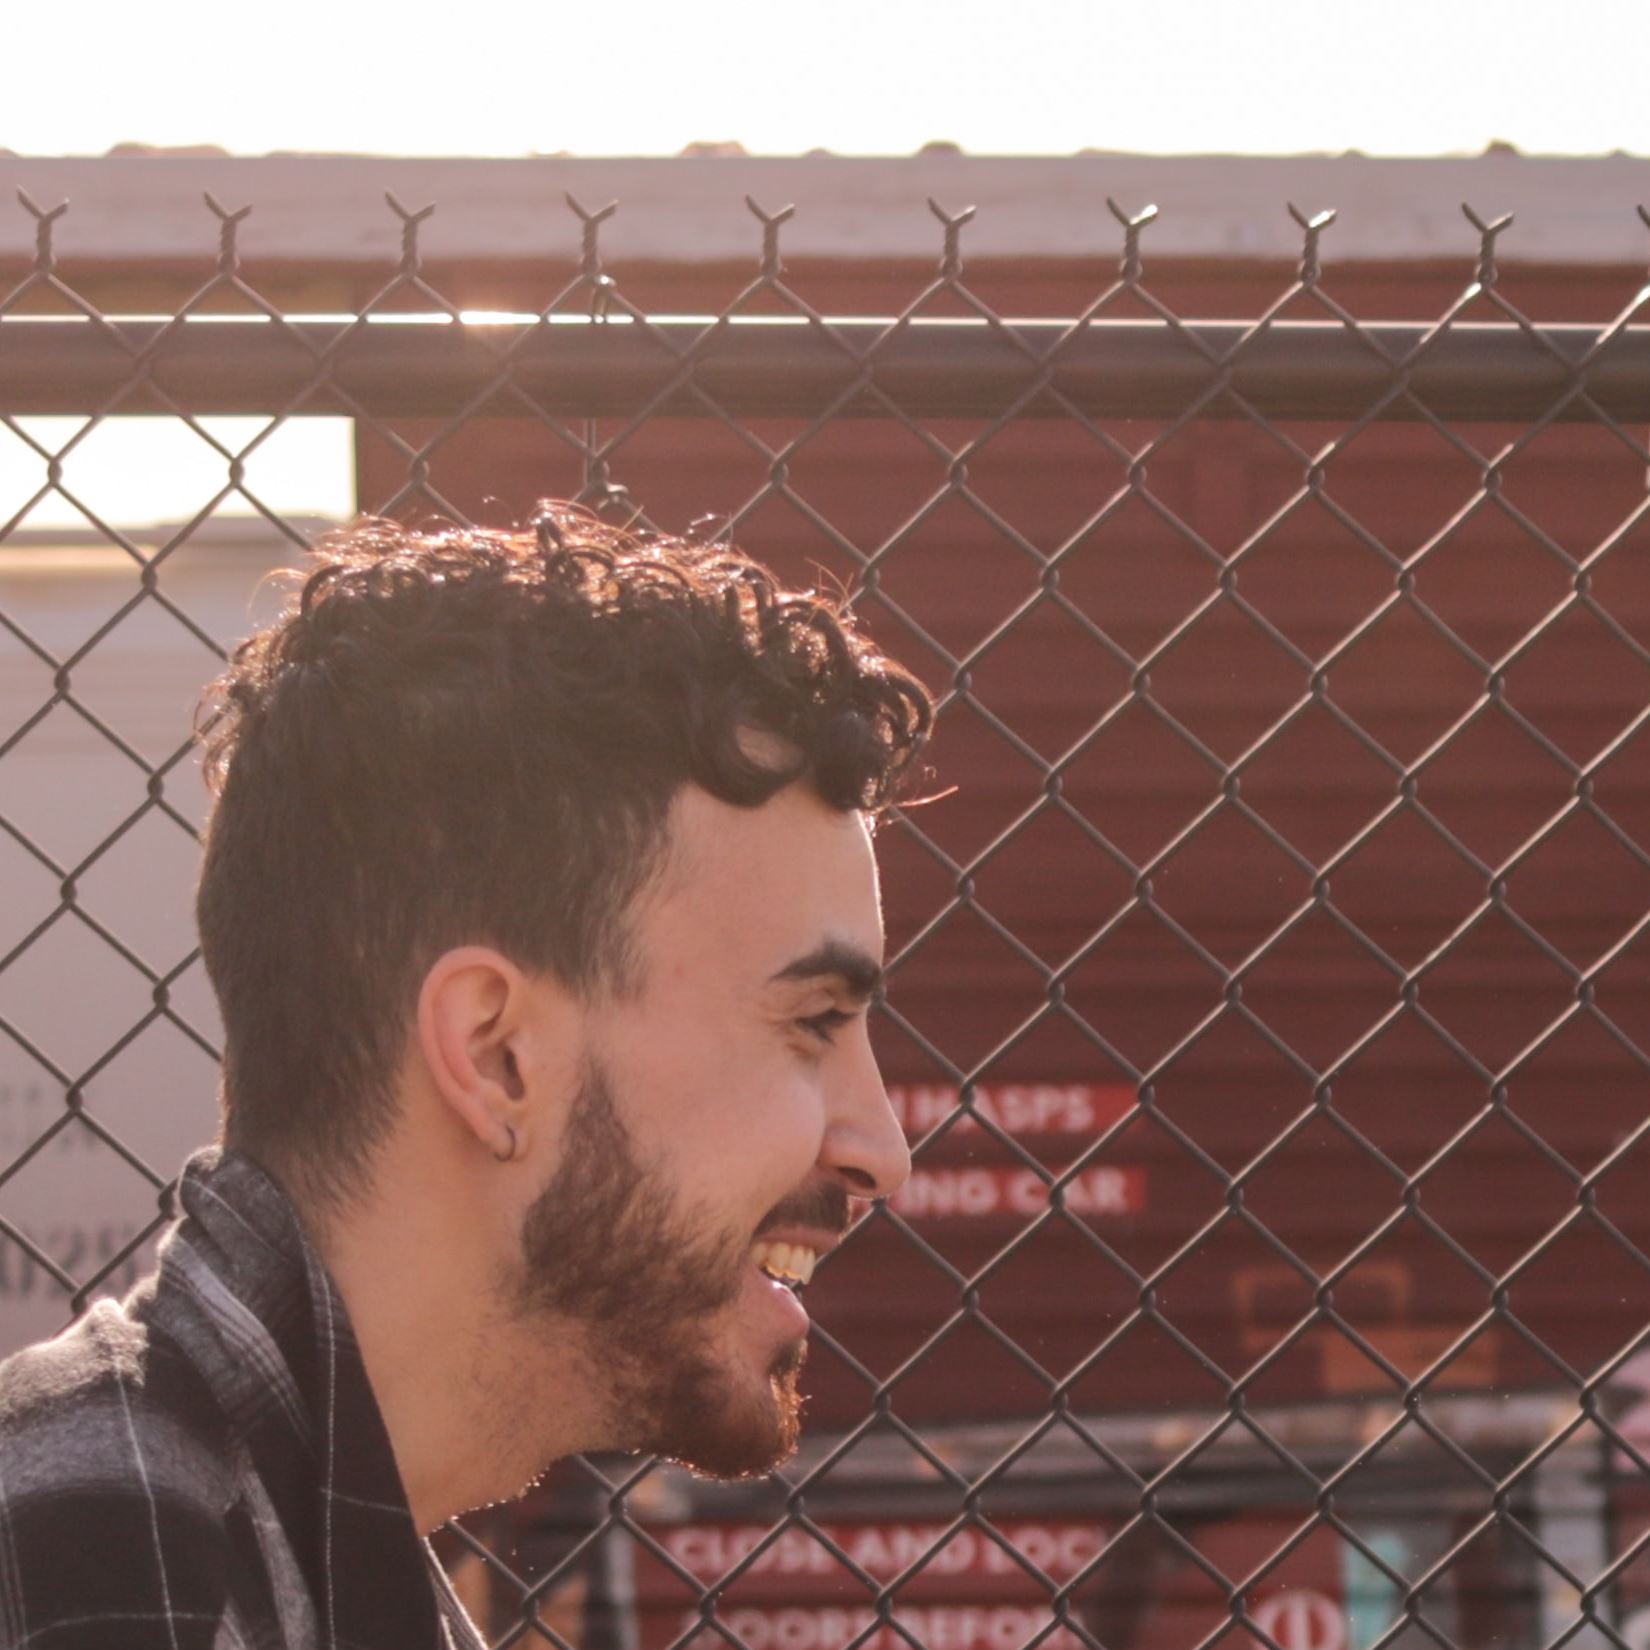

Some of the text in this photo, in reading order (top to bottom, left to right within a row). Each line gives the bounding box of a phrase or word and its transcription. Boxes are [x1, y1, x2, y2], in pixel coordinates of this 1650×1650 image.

[912, 1082, 1095, 1133] HASPS
[1007, 1168, 1128, 1215] CAR
[666, 1525, 1108, 1574] CLOSE AND LOC
